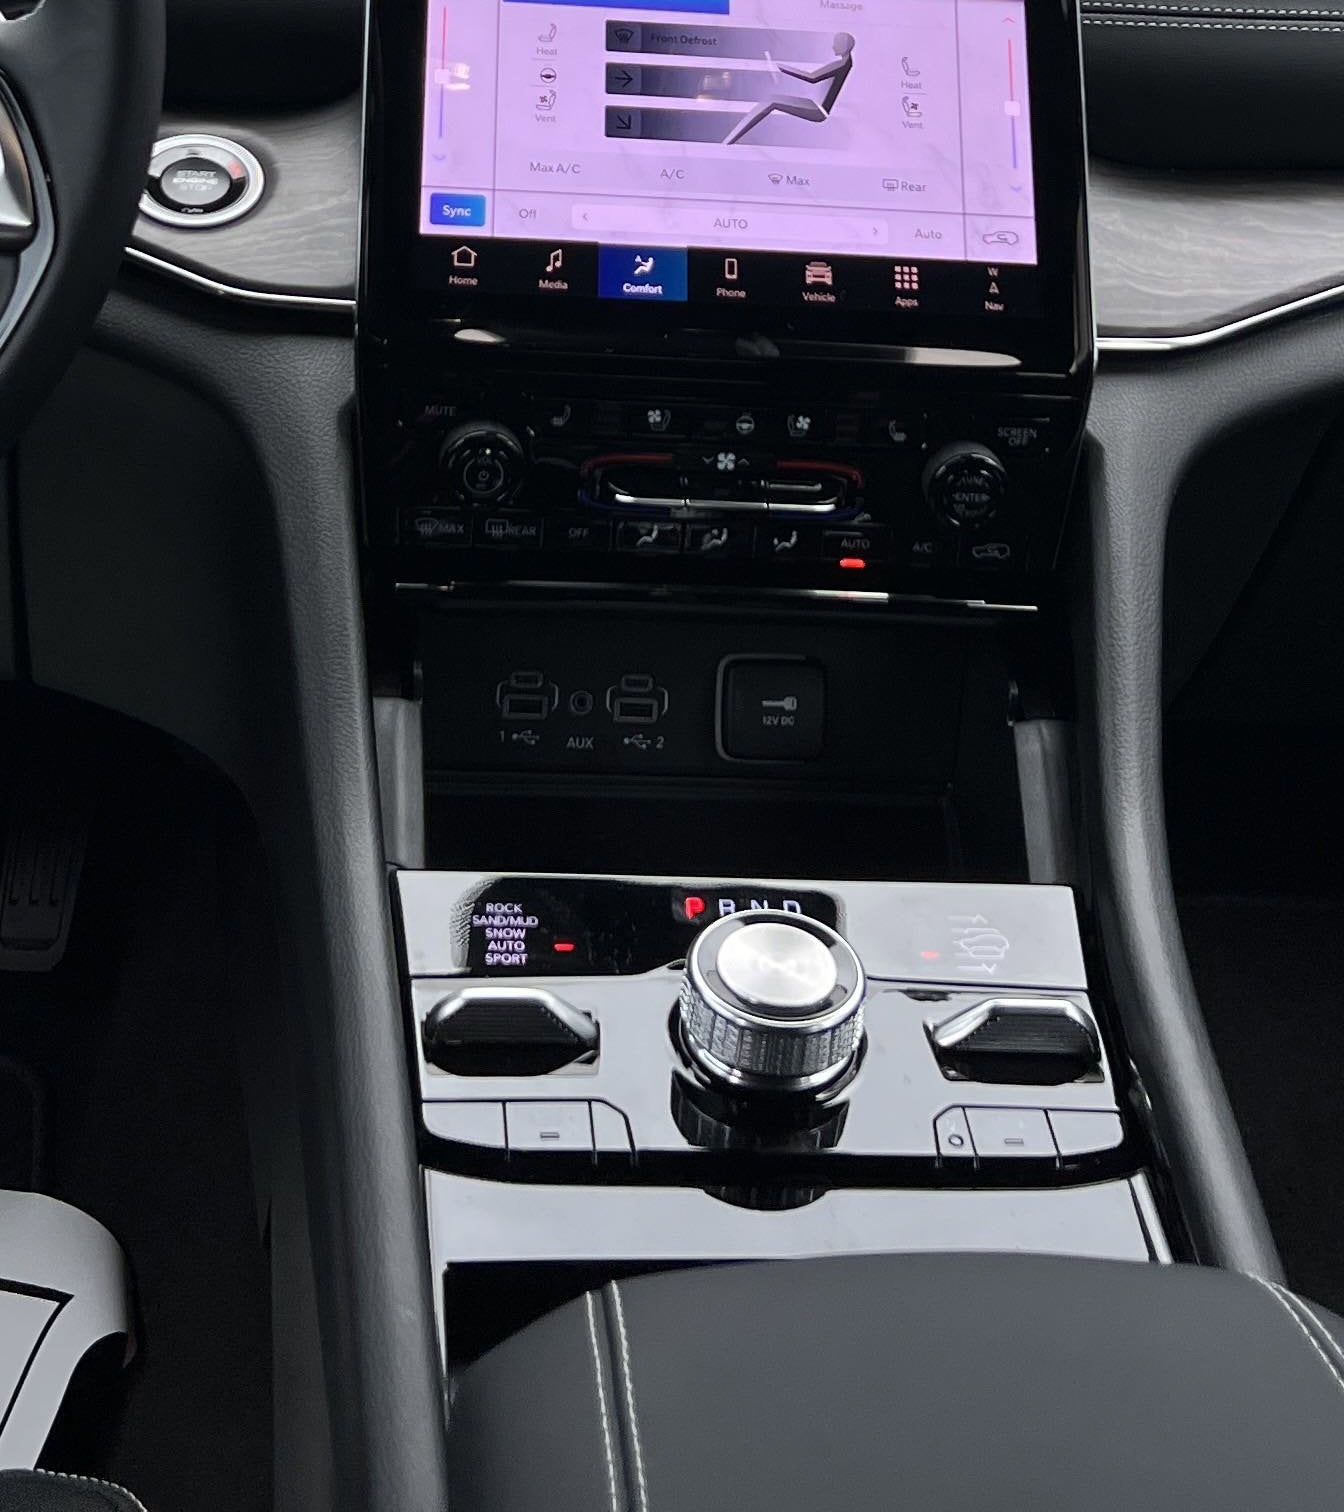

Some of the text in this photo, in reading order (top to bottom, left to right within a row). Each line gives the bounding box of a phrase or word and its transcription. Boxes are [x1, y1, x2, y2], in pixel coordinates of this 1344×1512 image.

[819, 0, 864, 11] Massage
[679, 35, 718, 46] Defrost
[900, 80, 923, 90] Heat
[902, 120, 924, 130] Vent
[529, 161, 582, 175] Max A/C
[659, 168, 685, 180] A/C
[786, 175, 810, 186] Max
[900, 181, 927, 192] Rear
[442, 204, 472, 218] Sync
[518, 208, 537, 219] Off
[713, 217, 748, 230] AUTO
[914, 229, 942, 240] Auto
[448, 275, 479, 286] Home
[538, 279, 569, 290] Media
[622, 283, 664, 295] Comfort
[716, 287, 746, 299] Phone
[802, 291, 836, 303] Vehicle
[894, 296, 919, 308] Apps
[984, 300, 1004, 311] Nav
[424, 405, 457, 417] MUTE
[997, 427, 1037, 439] SCREEN
[439, 523, 465, 534] MAX
[568, 527, 590, 537] OFF
[840, 538, 871, 550] AUTO
[912, 542, 933, 552] A/C
[763, 715, 779, 726] 12V
[499, 731, 505, 743] 1
[566, 736, 594, 750] AUX
[656, 736, 664, 748] 2
[485, 902, 523, 914] ROCK
[685, 896, 705, 919] P
[718, 898, 736, 917] R
[472, 914, 539, 927] SAND/MUD
[485, 927, 526, 940] SNOW
[487, 940, 526, 952] AUTO
[485, 952, 528, 965] SPORT
